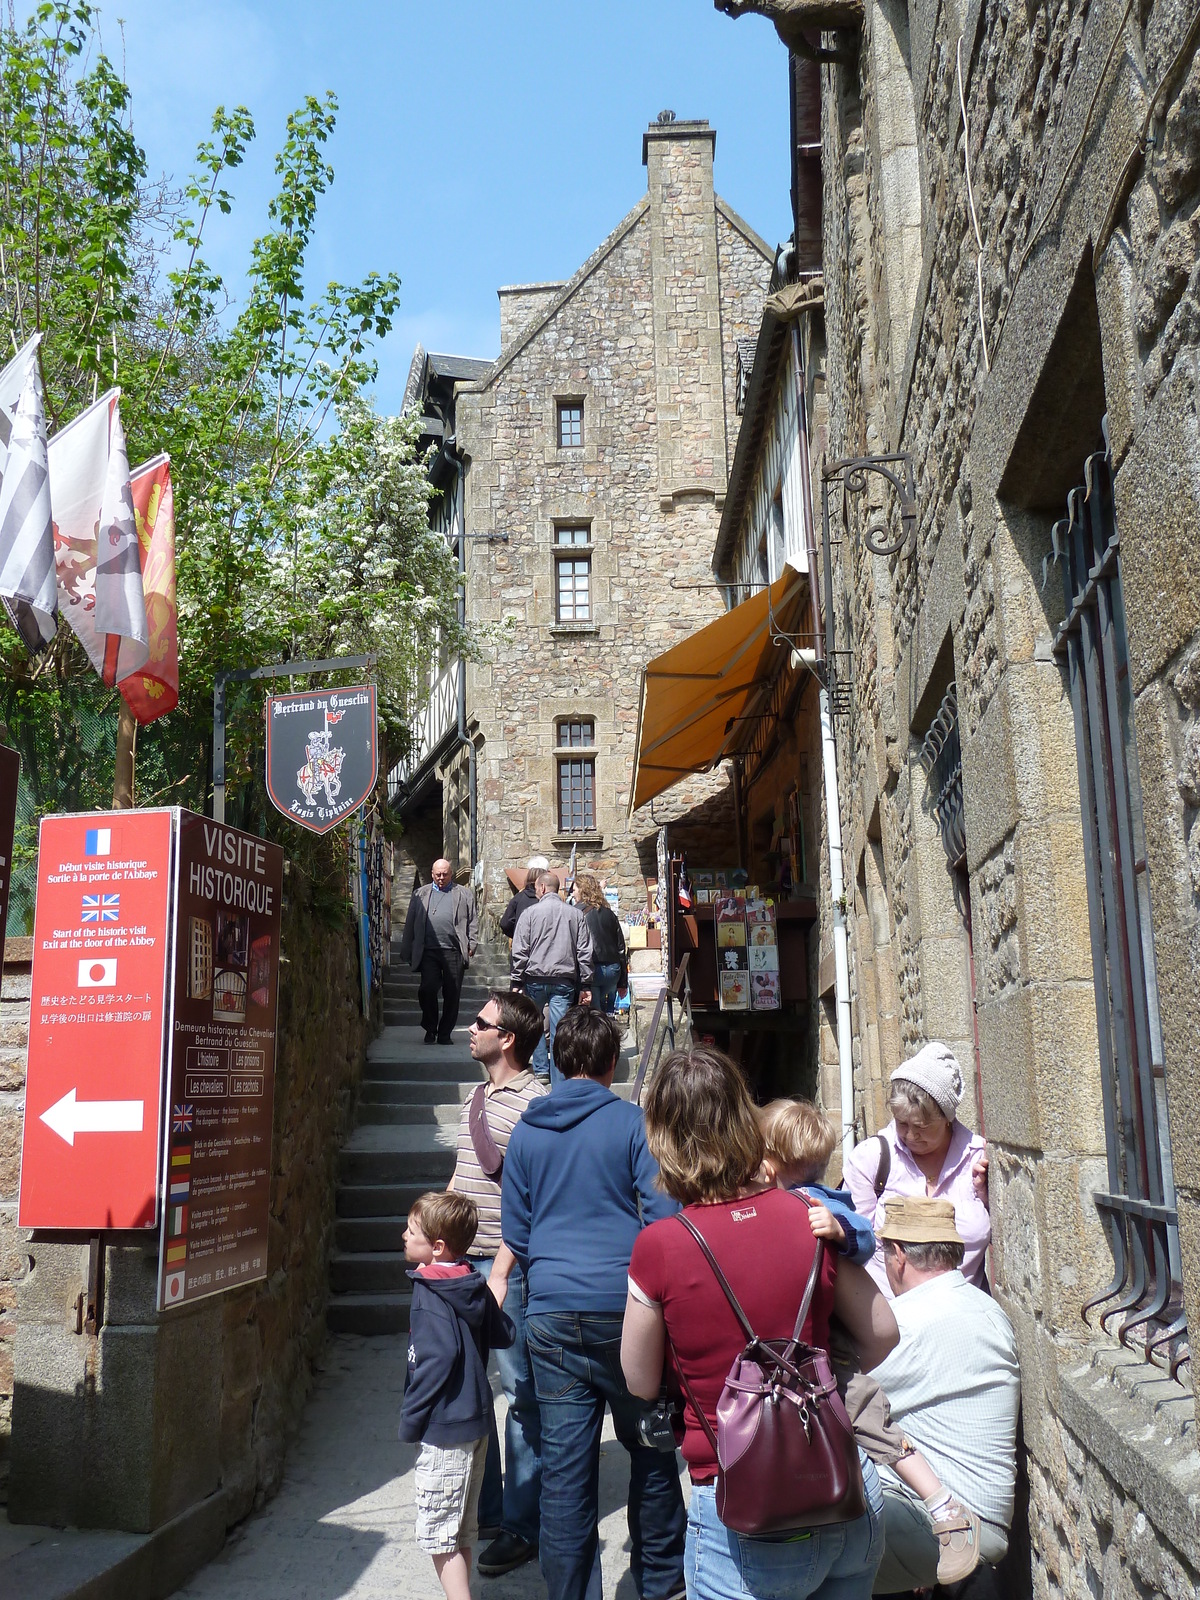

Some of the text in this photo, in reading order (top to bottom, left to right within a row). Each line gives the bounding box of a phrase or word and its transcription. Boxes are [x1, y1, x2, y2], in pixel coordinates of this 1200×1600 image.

[272, 694, 369, 718] Bertrand du Guesclin
[288, 797, 354, 820] Logis Tiphaine
[203, 823, 266, 875] VISITE
[59, 860, 147, 872] Début visite historique
[48, 870, 158, 883] Sortie à la porte de l'Abbaye
[190, 862, 273, 915] HISTORIQUE
[52, 925, 146, 938] Start of the historic visit
[43, 936, 156, 949] Exit at the door of the Abbey
[41, 993, 151, 1006] 歴史をたどる見学スタート
[40, 1010, 152, 1024] 見学後の出口は修道院の扉
[175, 1020, 275, 1038] Demeure historique du Chevalier
[195, 1035, 259, 1048] Bertrand du Guesclin
[197, 1052, 219, 1067] L'histoire
[244, 1053, 260, 1069] prisons
[190, 1079, 224, 1094] Les chevaliers
[234, 1079, 259, 1093] Les cachots
